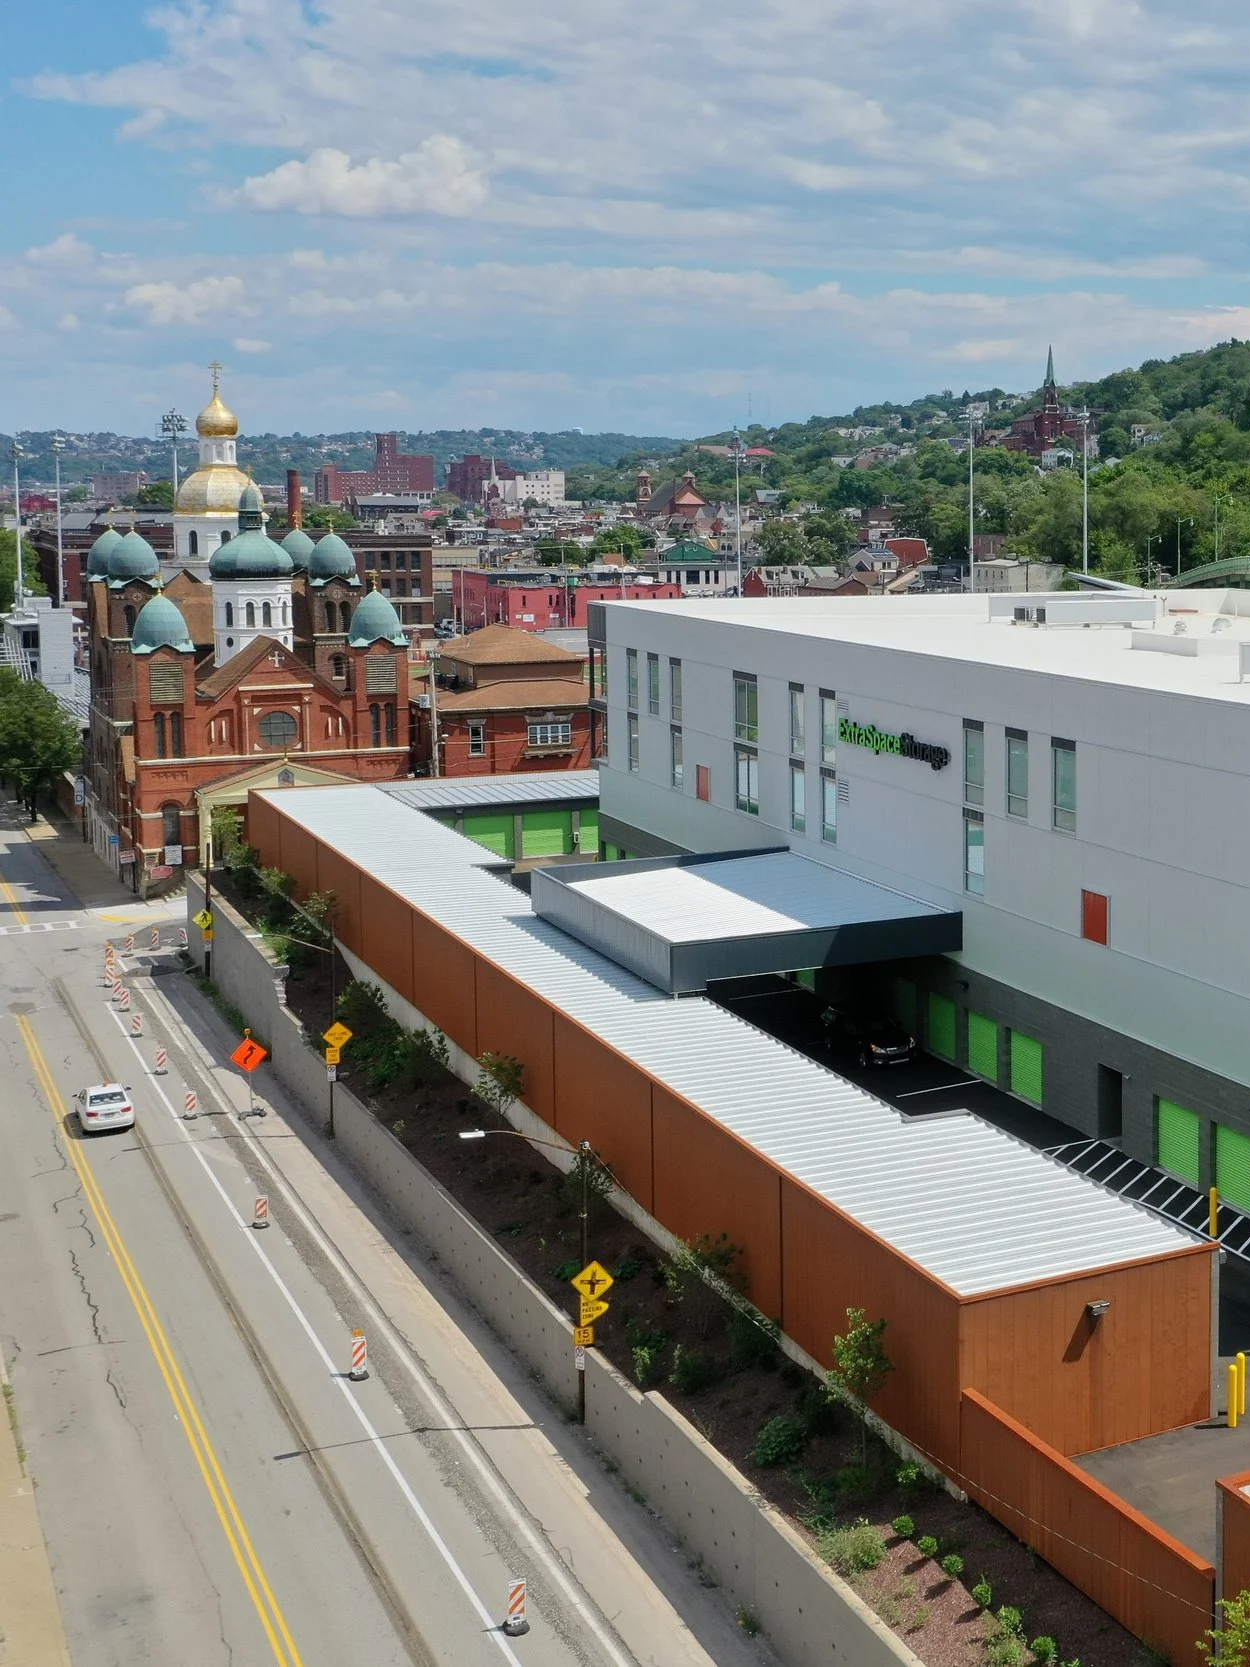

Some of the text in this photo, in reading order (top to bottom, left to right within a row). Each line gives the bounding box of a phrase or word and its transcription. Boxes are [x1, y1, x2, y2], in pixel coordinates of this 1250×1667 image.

[838, 718, 951, 771] ExtraSpace Storage
[577, 1329, 590, 1338] 15
